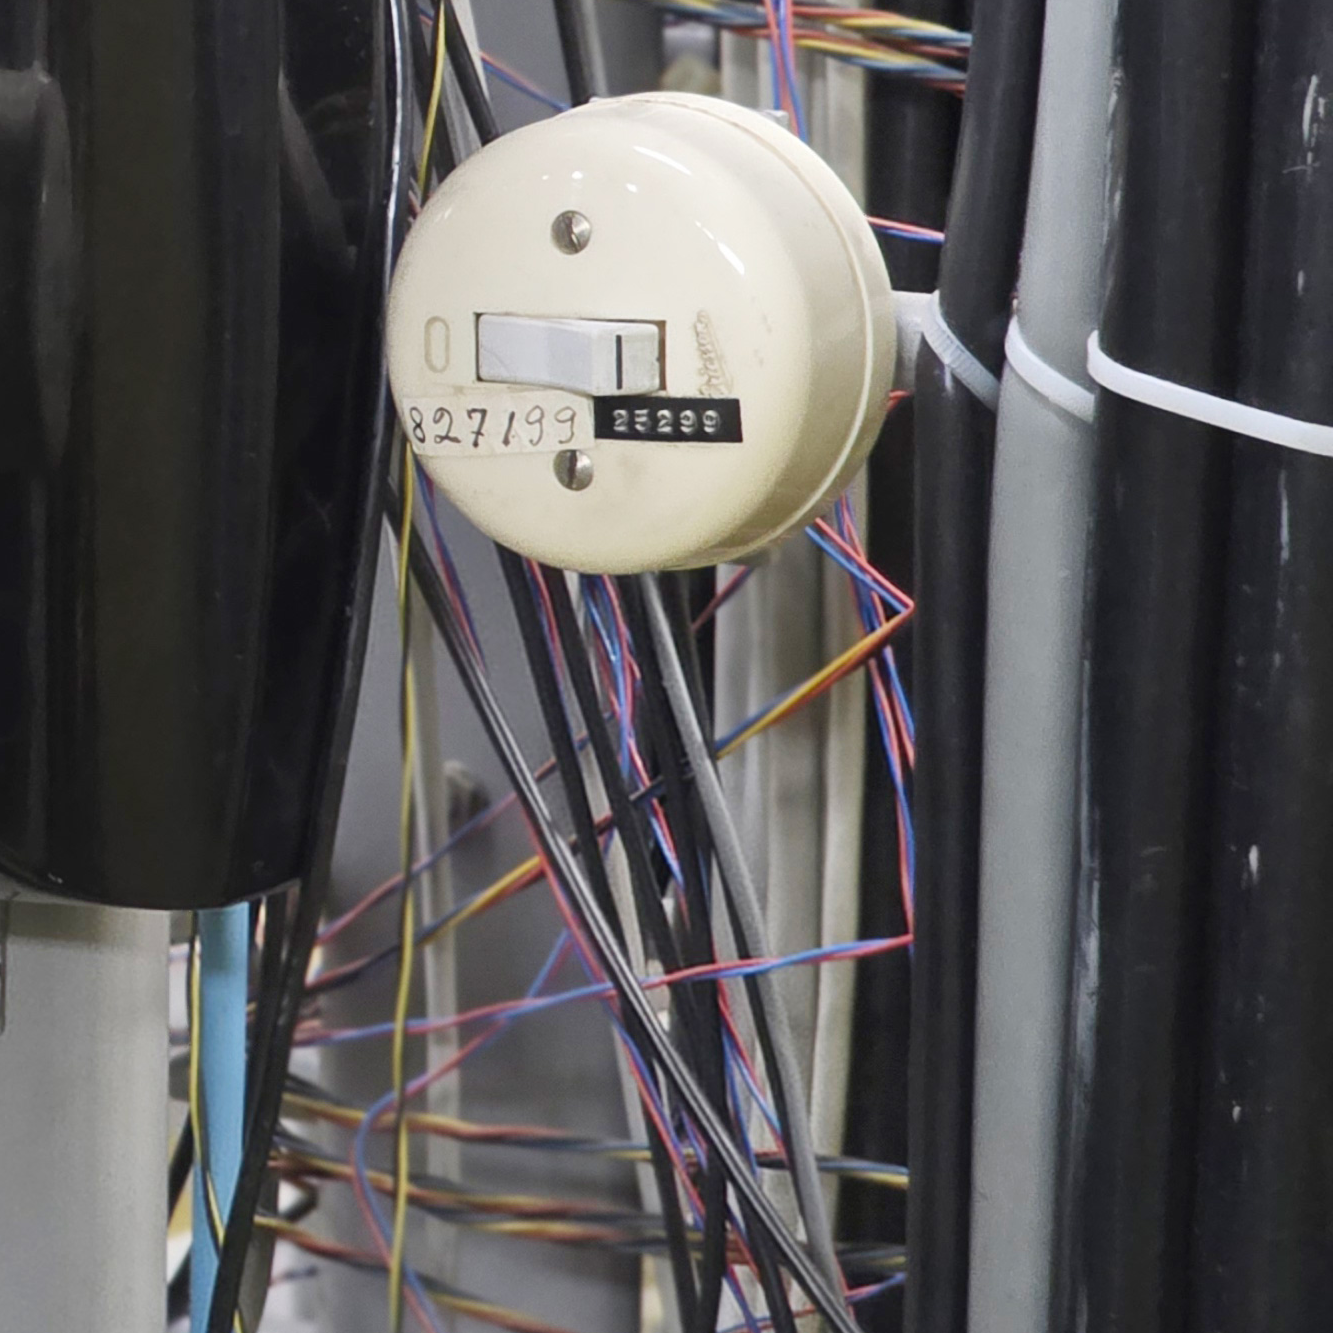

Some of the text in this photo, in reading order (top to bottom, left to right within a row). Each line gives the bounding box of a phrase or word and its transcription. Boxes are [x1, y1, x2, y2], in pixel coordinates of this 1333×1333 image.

[424, 316, 450, 373] 0
[409, 404, 578, 449] 827199
[612, 408, 721, 435] 25299
